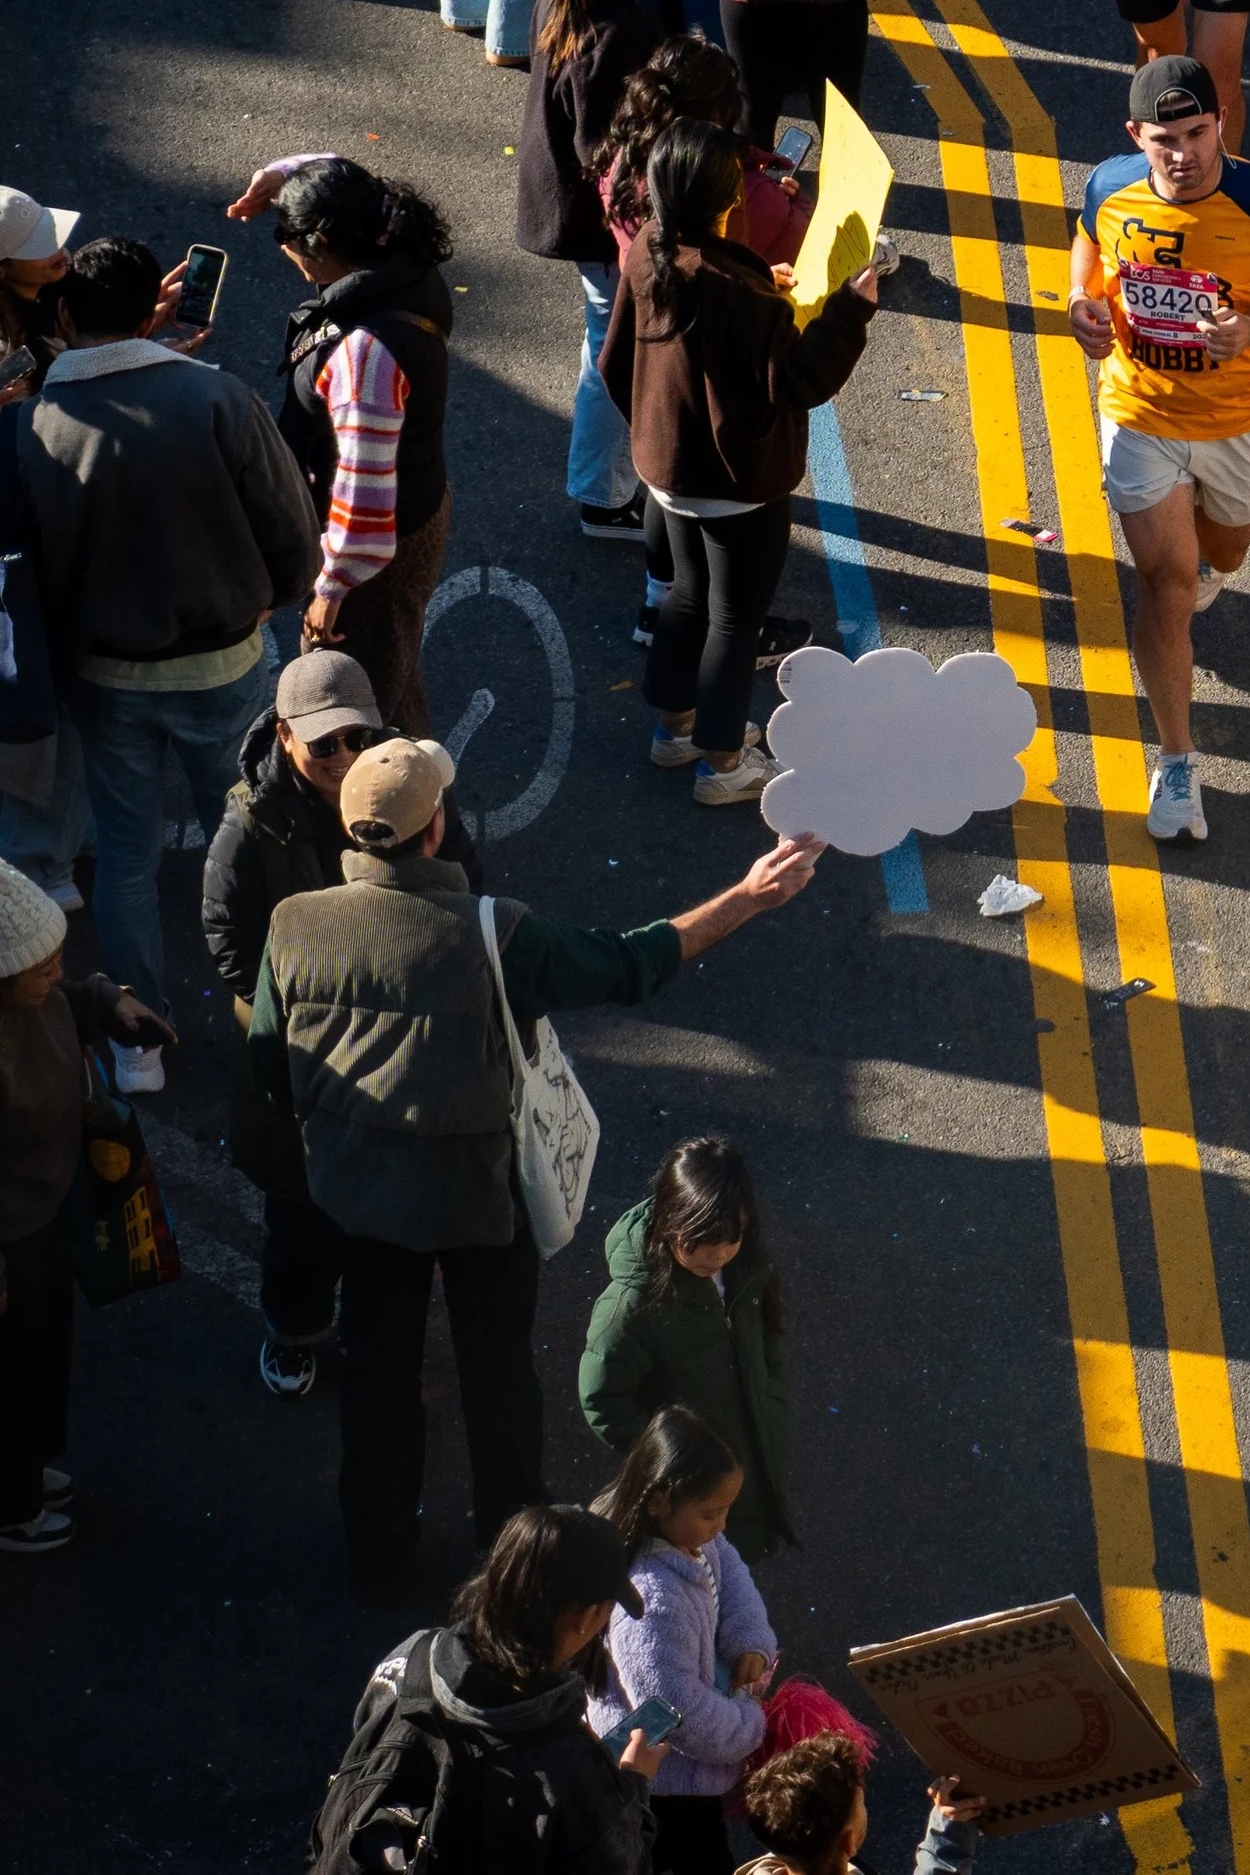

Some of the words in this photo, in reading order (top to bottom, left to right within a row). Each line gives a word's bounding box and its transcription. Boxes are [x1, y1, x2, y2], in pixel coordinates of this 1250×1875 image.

[1130, 264, 1151, 281] tcs
[1190, 282, 1205, 290] TATA
[1125, 281, 1212, 314] 58420
[1150, 311, 1186, 322] ROBERT
[949, 1728, 1024, 1776] Baked
[1034, 1750, 1092, 1775] Oven
